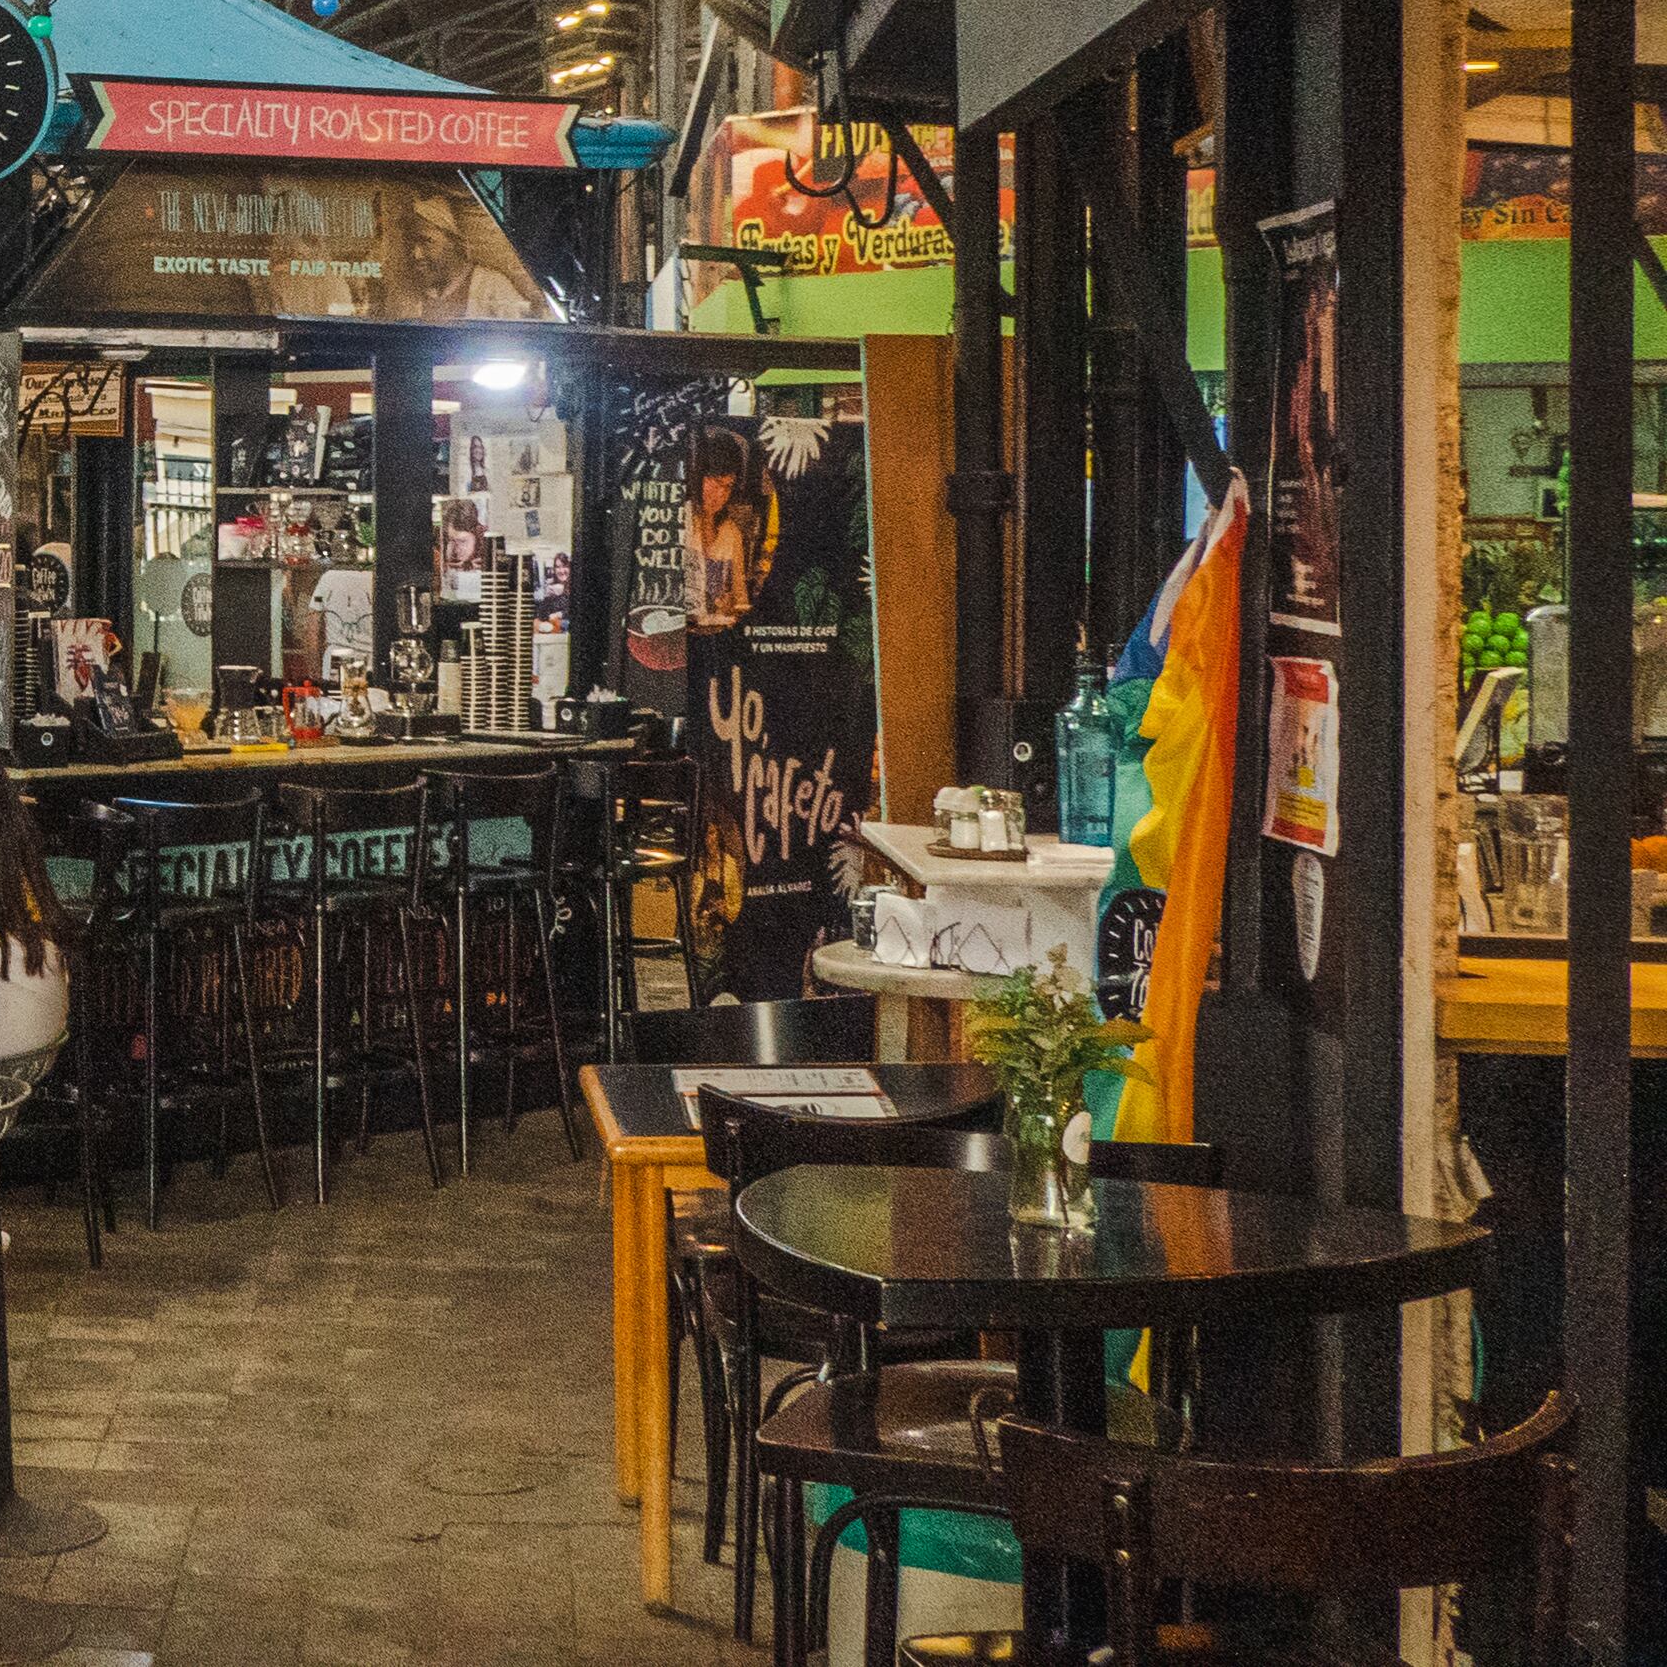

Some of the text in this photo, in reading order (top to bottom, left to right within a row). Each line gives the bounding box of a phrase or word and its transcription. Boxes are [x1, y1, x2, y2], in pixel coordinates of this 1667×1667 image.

[144, 97, 530, 149] SPECIALTY ROASTED COFFEE
[153, 255, 214, 276] EXOTIC
[217, 257, 271, 278] TASTE
[329, 260, 384, 279] TRADE
[638, 504, 672, 527] YOU
[641, 527, 671, 546] DO
